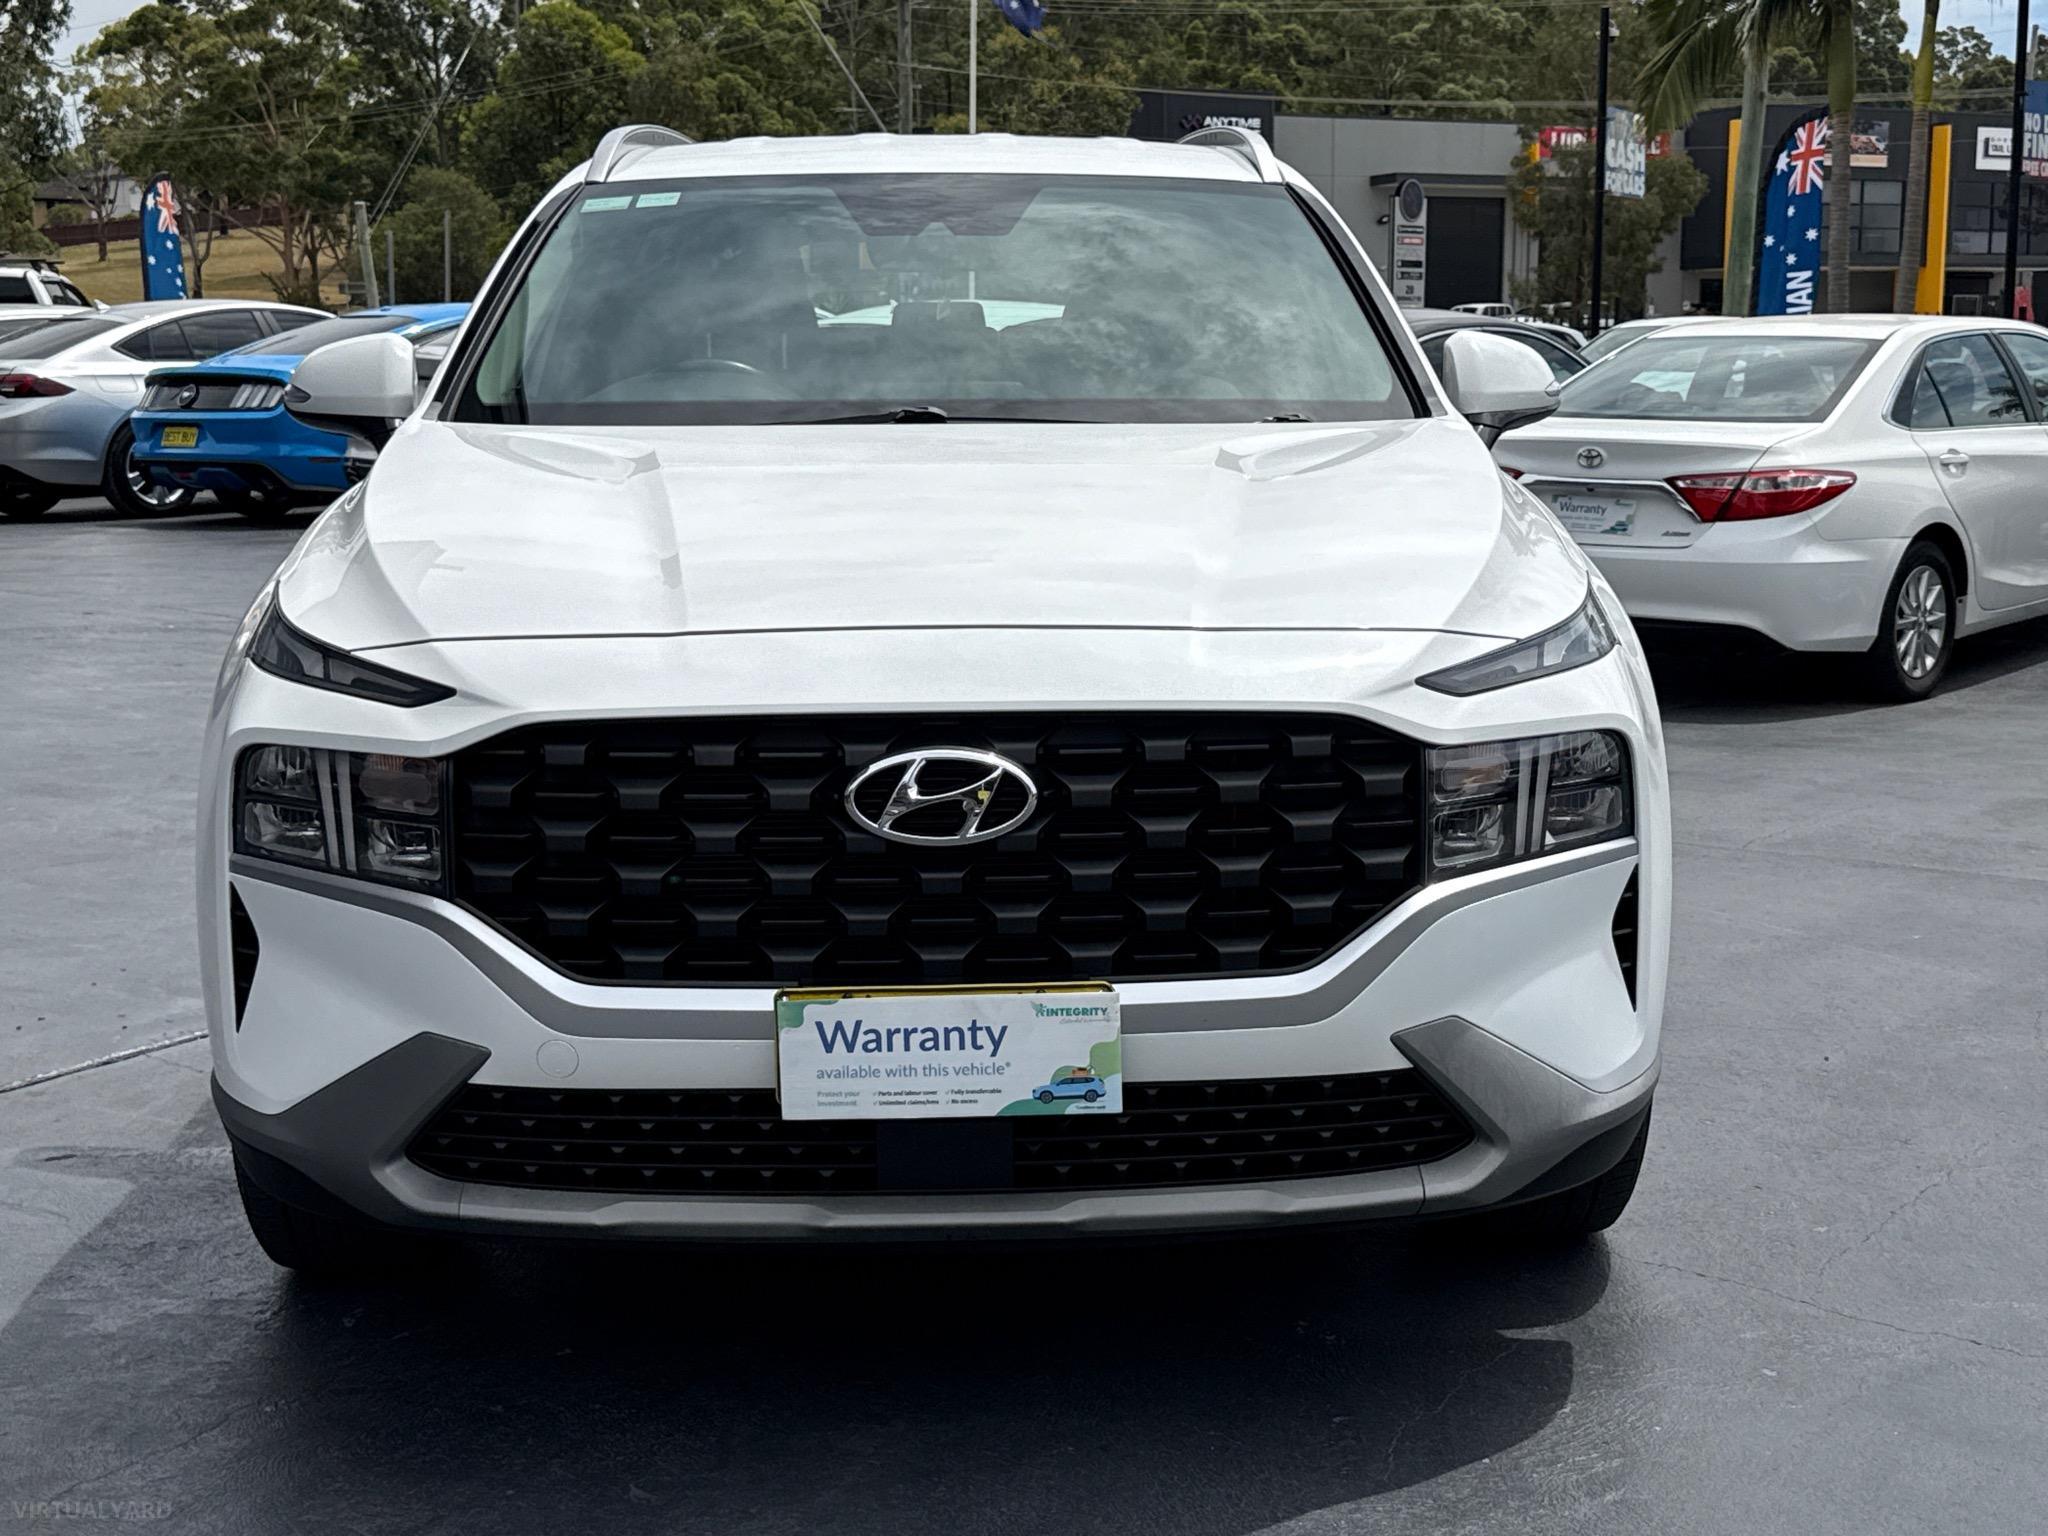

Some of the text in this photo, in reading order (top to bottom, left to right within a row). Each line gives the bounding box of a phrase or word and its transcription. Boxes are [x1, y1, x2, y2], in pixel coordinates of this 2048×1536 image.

[1203, 115, 1262, 129] ANYTIME
[1605, 138, 1646, 174] CASH
[1785, 270, 1813, 315] IAN
[1560, 501, 1608, 516] Warranty
[1046, 1007, 1108, 1017] INTEGRITY
[815, 1019, 1009, 1057] Warranty
[816, 1064, 881, 1080] available
[885, 1063, 918, 1078] with
[922, 1063, 949, 1078] this
